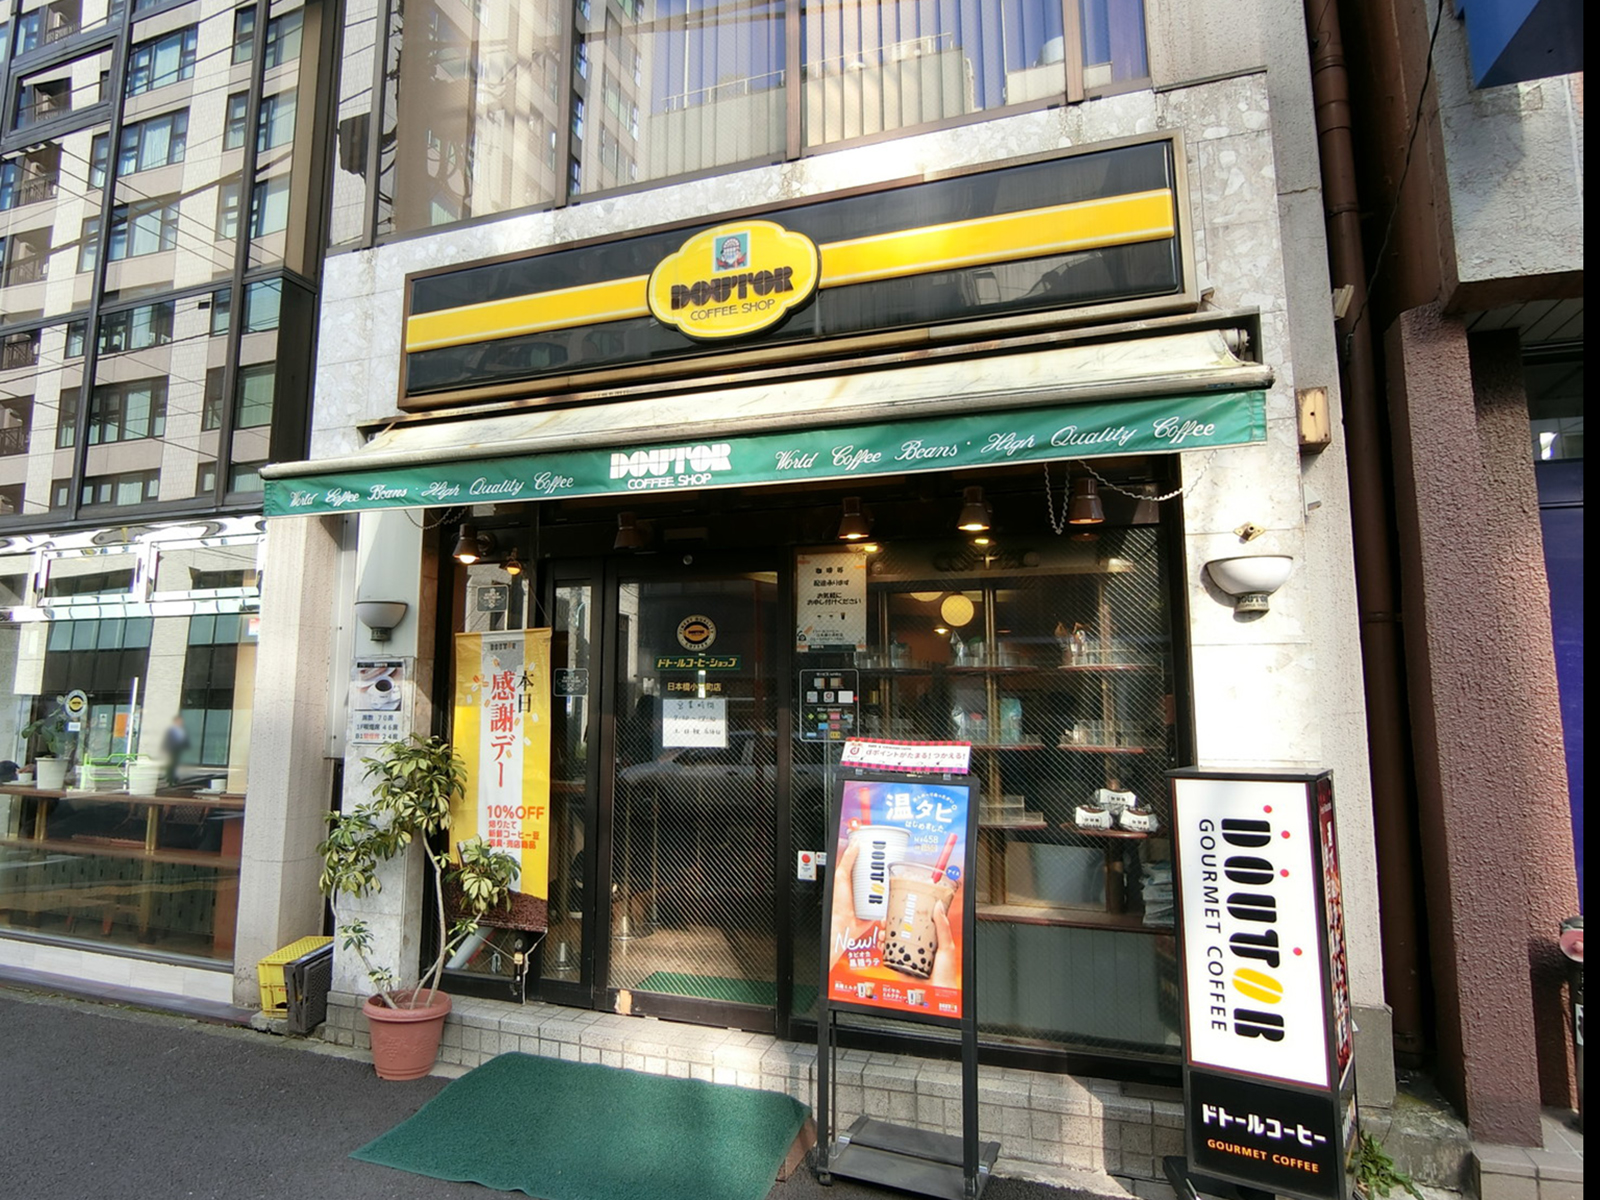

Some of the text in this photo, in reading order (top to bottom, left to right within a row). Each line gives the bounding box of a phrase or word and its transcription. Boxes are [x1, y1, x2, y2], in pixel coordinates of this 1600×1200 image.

[671, 266, 794, 310] DOUTOR
[690, 298, 776, 321] COFFEE SHOP
[774, 415, 1216, 471] World Coffee Beans High Quality Coffee
[609, 443, 732, 480] DOUTOR
[367, 484, 408, 501] Beans
[421, 481, 461, 498] High
[469, 476, 525, 497] Quality
[533, 471, 575, 494] Coffee
[627, 472, 712, 490] COFFEE SHOP
[490, 642, 517, 651] DOUTOR
[657, 658, 738, 668] ドトールコーヒーショップ
[517, 670, 534, 713] 本日
[667, 682, 722, 691] 日本橋小町店
[490, 670, 516, 788] 感謝デー
[487, 805, 545, 820] 10%OFF
[886, 792, 957, 823] 温タピ
[905, 820, 948, 835] はじめました。
[834, 926, 879, 953] New!
[1199, 819, 1227, 1031] GOURMET COFFEE
[1221, 818, 1285, 1042] DOUTOR
[1202, 1103, 1327, 1146] ドトールコーヒー
[1207, 1138, 1319, 1173] GOURMET COFFEE
